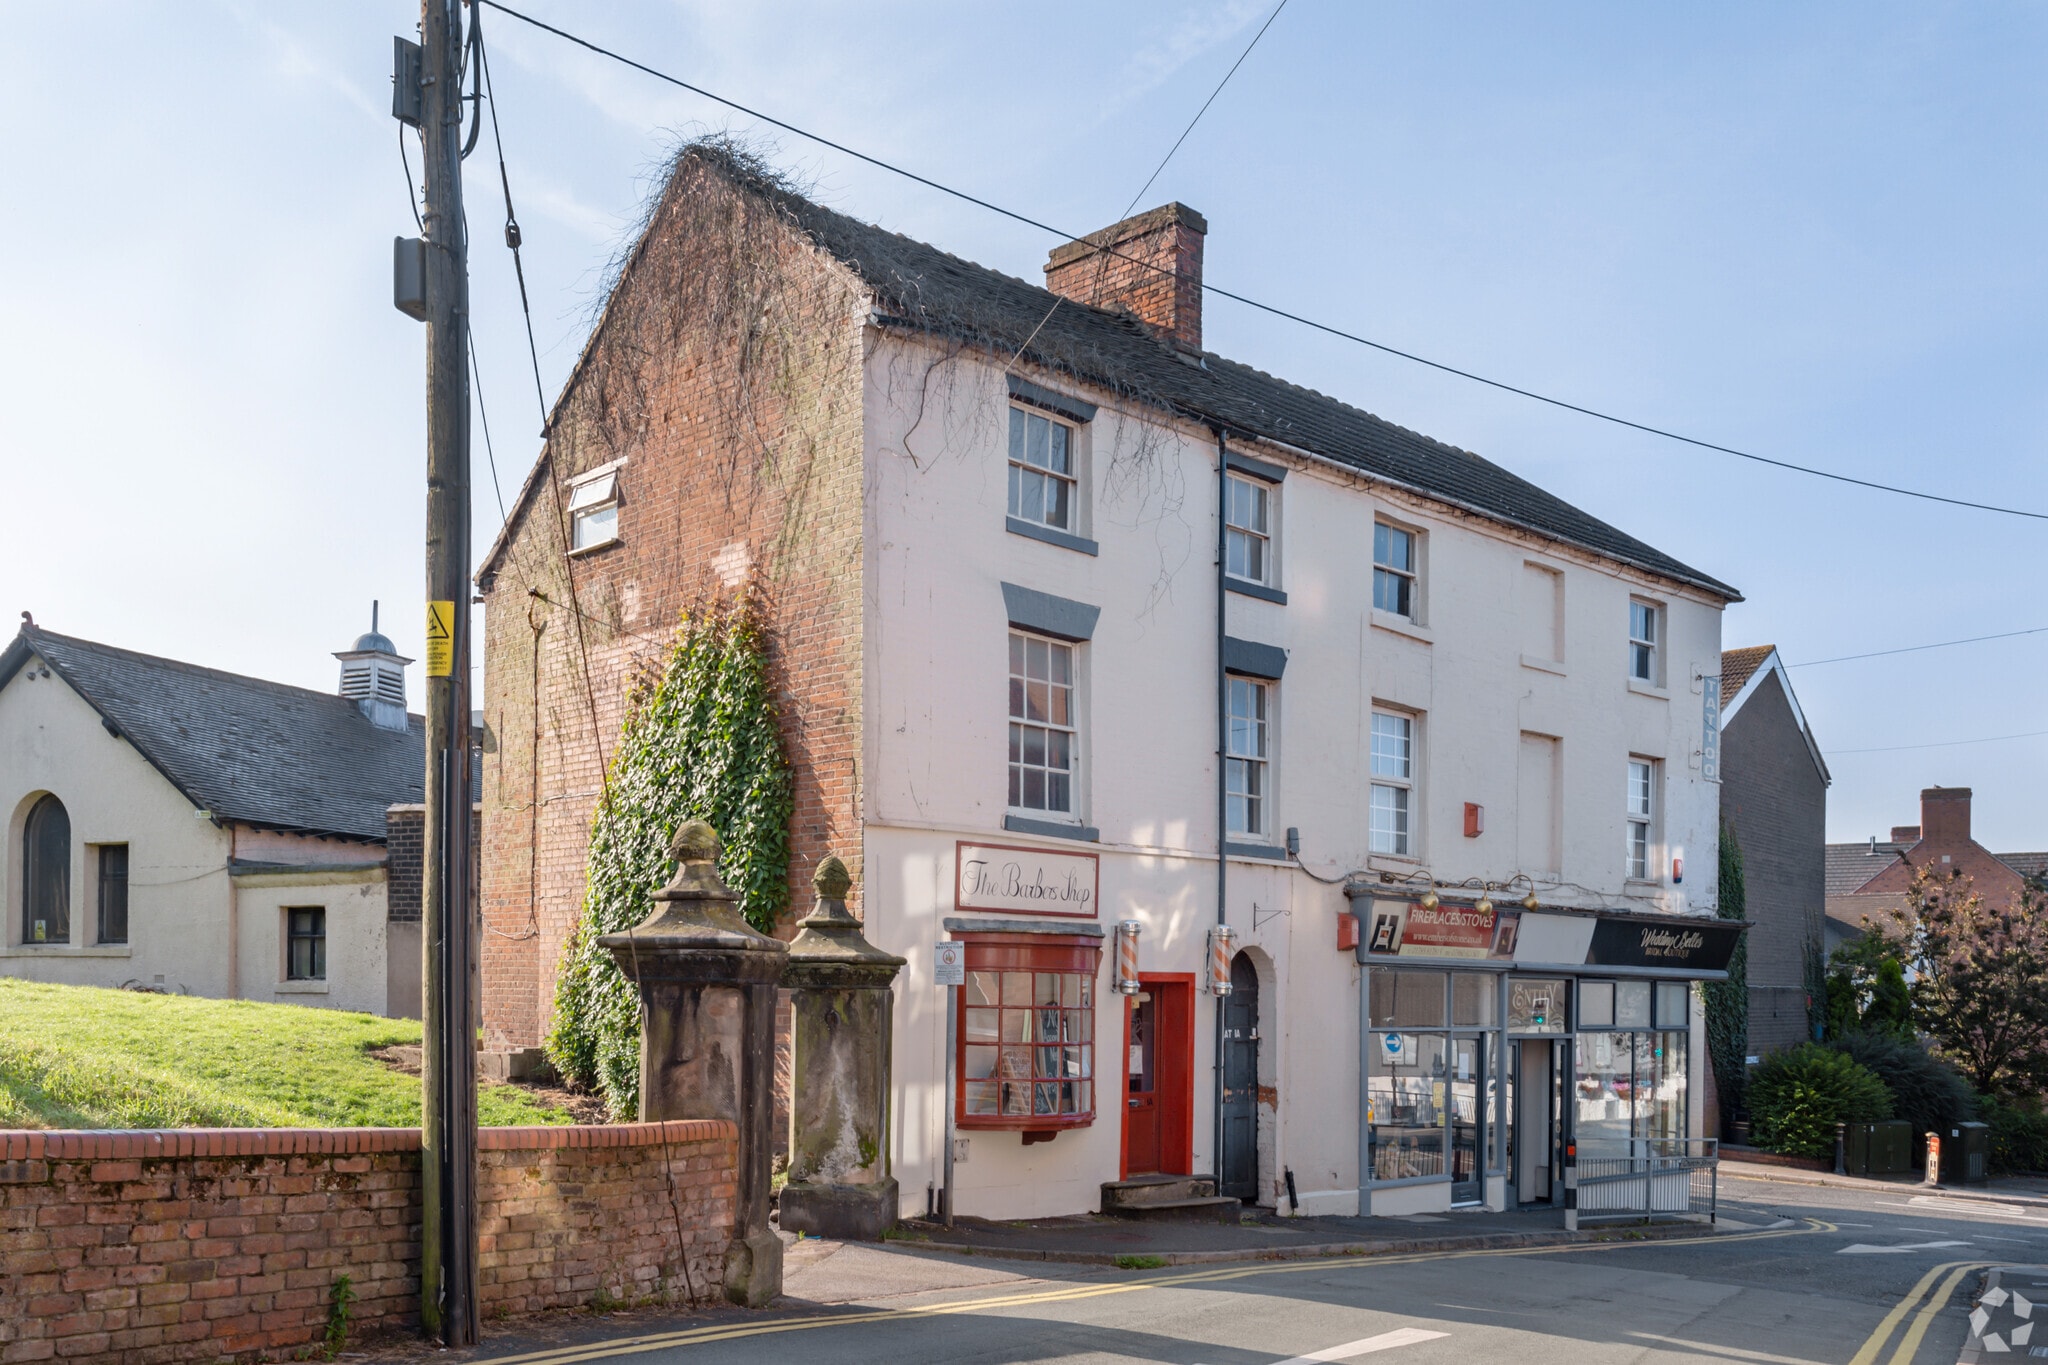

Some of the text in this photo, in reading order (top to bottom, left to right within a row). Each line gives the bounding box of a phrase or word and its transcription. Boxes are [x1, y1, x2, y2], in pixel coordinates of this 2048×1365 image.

[1704, 680, 1716, 776] TATTOO
[962, 860, 1090, 910] The Barbers Shop
[1410, 908, 1494, 928] FIREPLACES/STOVES
[1641, 927, 1704, 955] Wedding Belles
